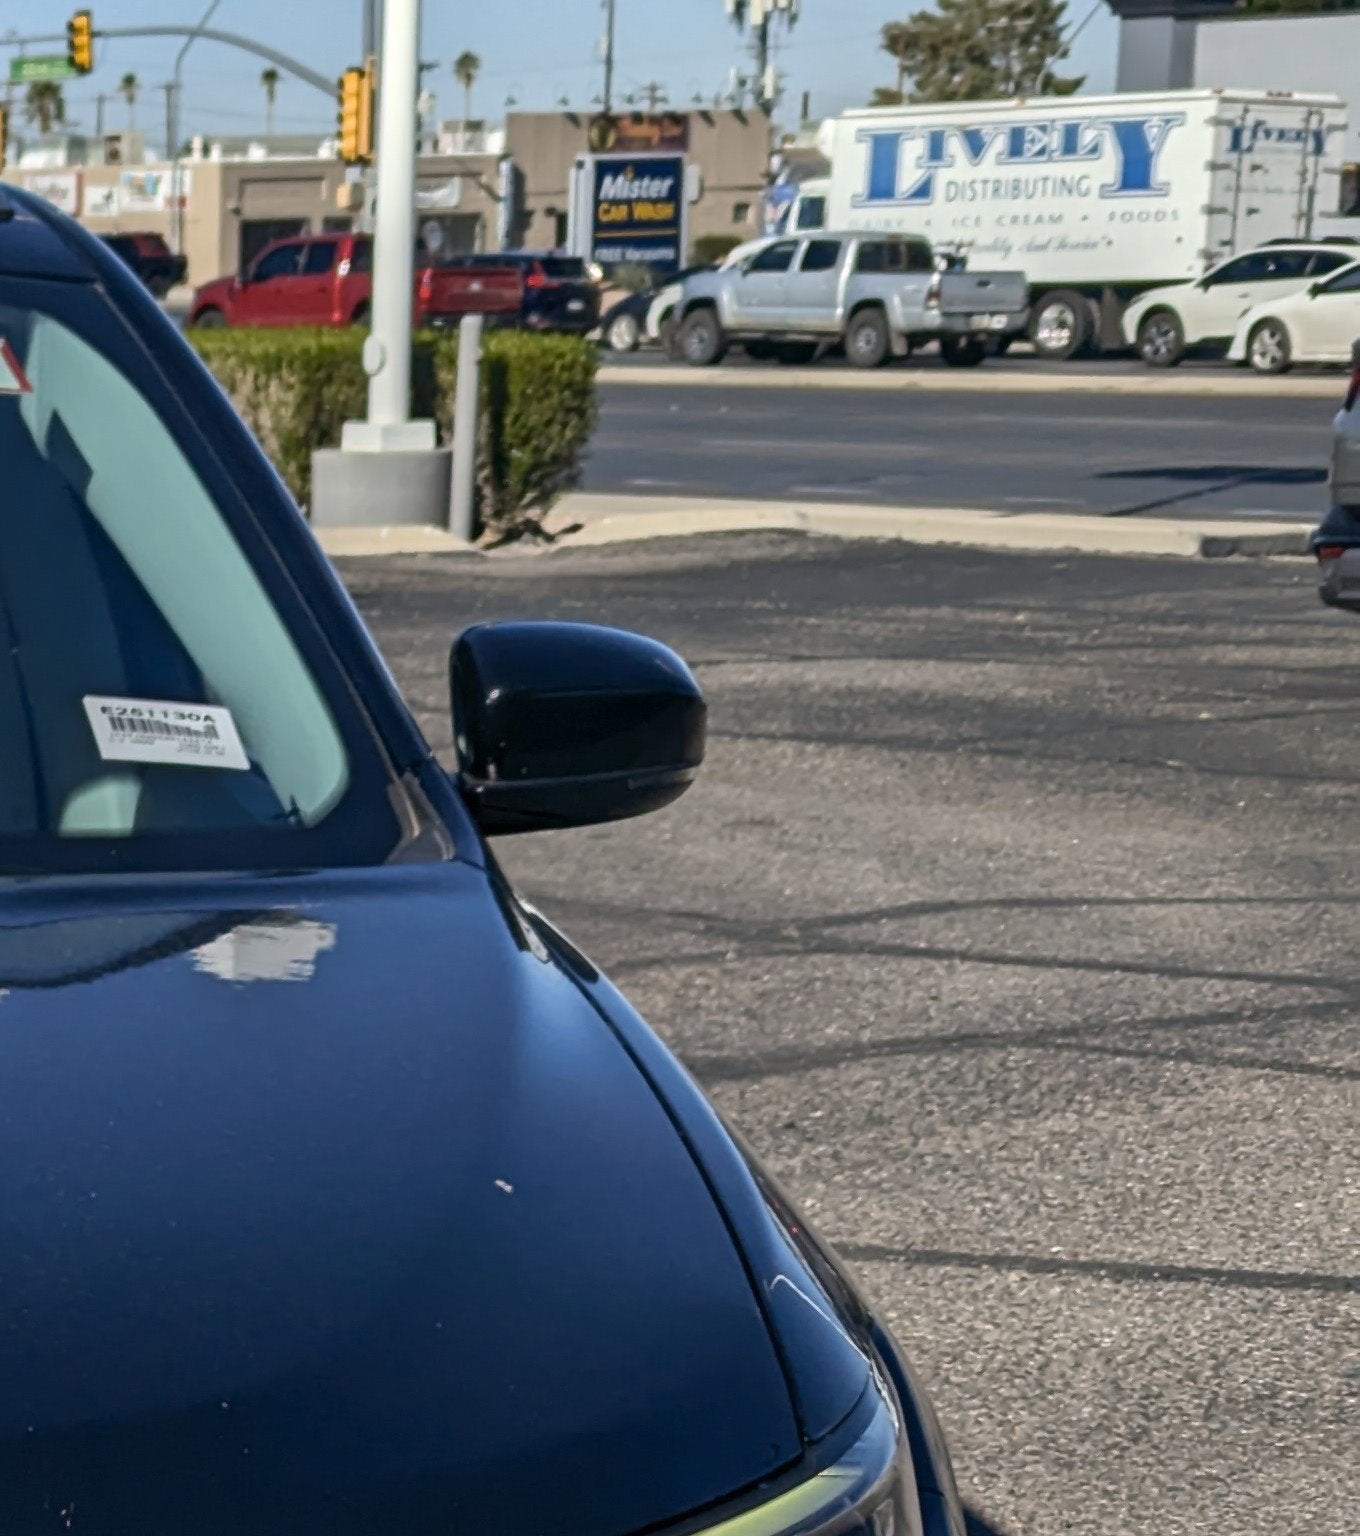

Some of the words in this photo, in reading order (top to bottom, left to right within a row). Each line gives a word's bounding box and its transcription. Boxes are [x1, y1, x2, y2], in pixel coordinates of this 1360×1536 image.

[851, 112, 1186, 208] LIVELY
[599, 172, 674, 200] Mister
[944, 174, 1092, 202] DISTRIBUTING
[598, 203, 629, 222] CAR
[951, 215, 982, 228] ICE
[995, 213, 1065, 227] CREAM
[1108, 209, 1180, 223] FOODS
